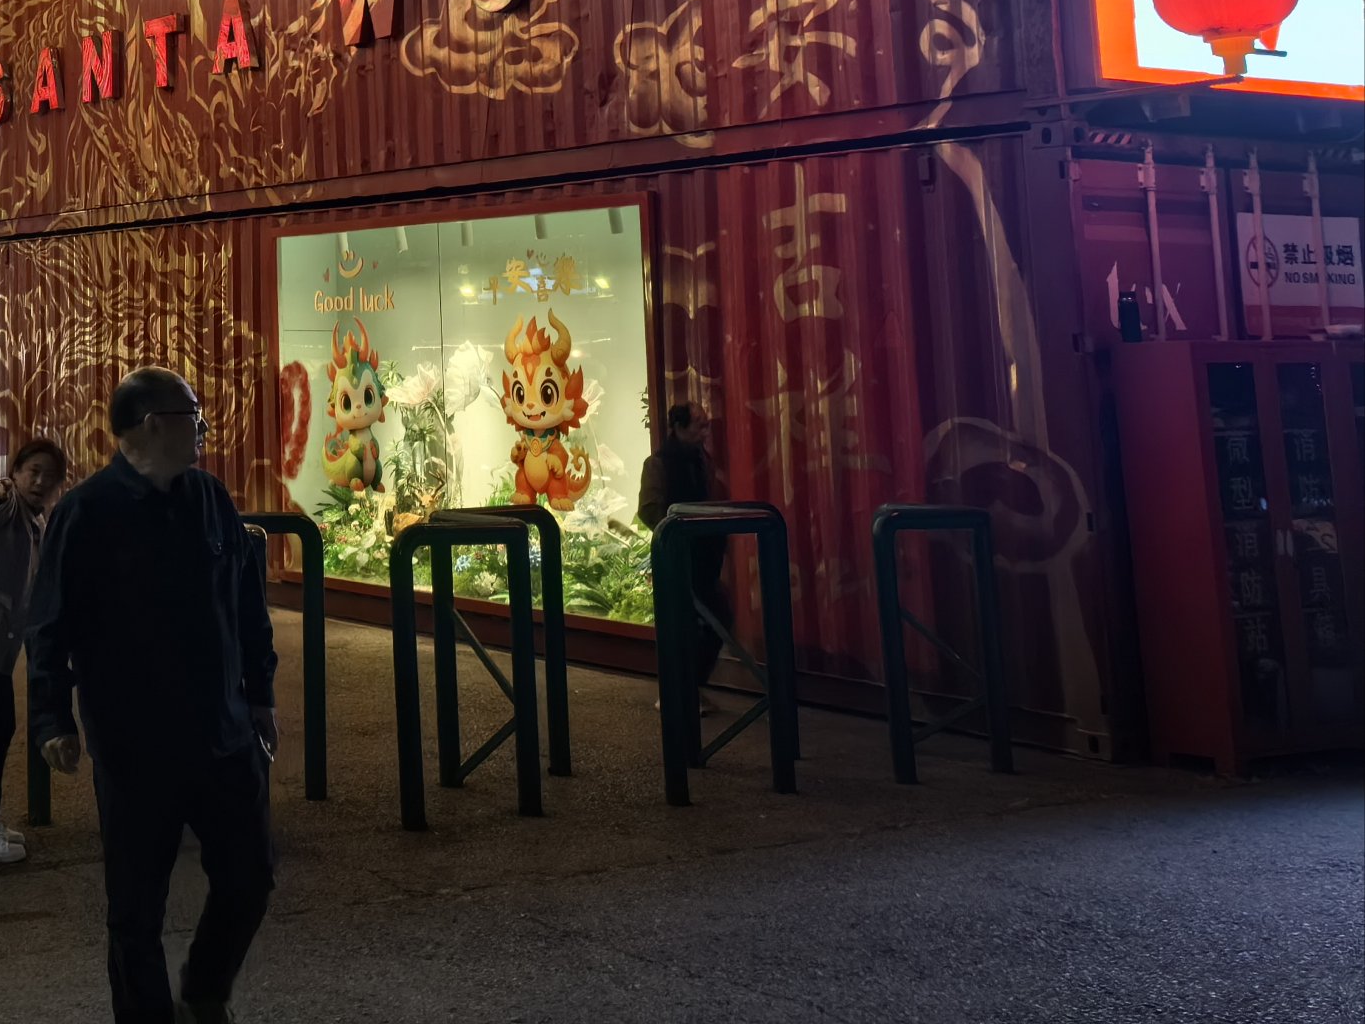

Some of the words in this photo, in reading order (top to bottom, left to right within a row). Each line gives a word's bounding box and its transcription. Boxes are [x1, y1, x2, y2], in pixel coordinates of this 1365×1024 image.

[1284, 271, 1300, 284] NO
[1301, 272, 1356, 285] SMKING
[314, 286, 354, 314] Good
[359, 282, 396, 312] luck
